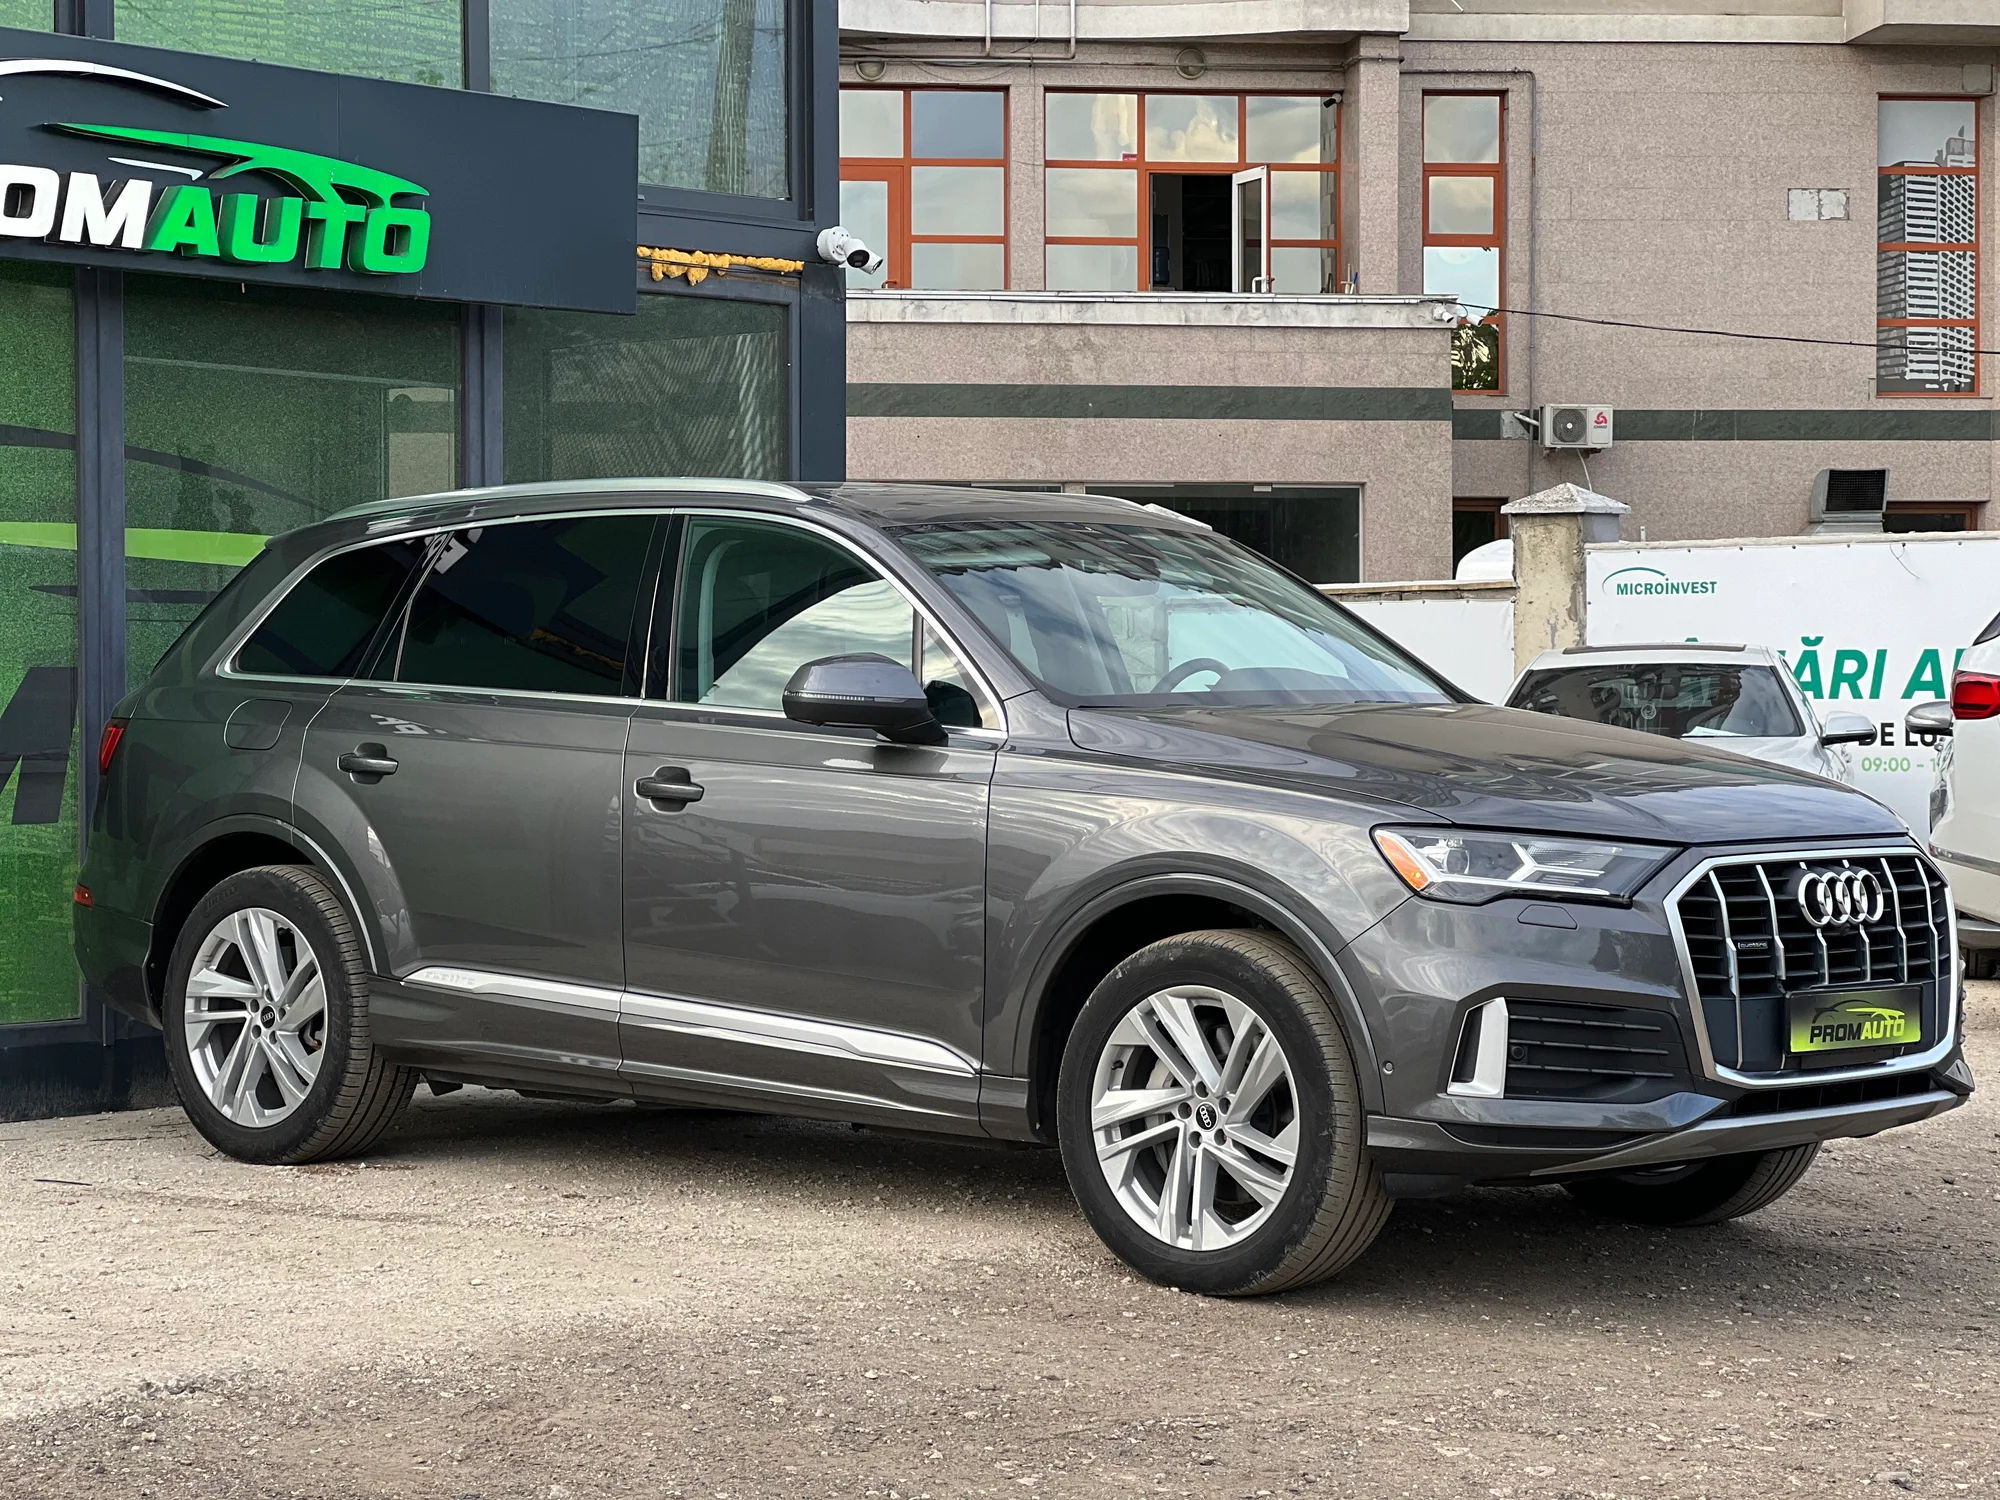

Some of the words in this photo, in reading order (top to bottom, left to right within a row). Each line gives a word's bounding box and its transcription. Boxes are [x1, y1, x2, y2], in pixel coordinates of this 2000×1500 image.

[1782, 635, 1888, 700] ĂRI
[1861, 756, 1911, 773] 09:00
[1809, 1018, 1906, 1044] PROMAUTO
